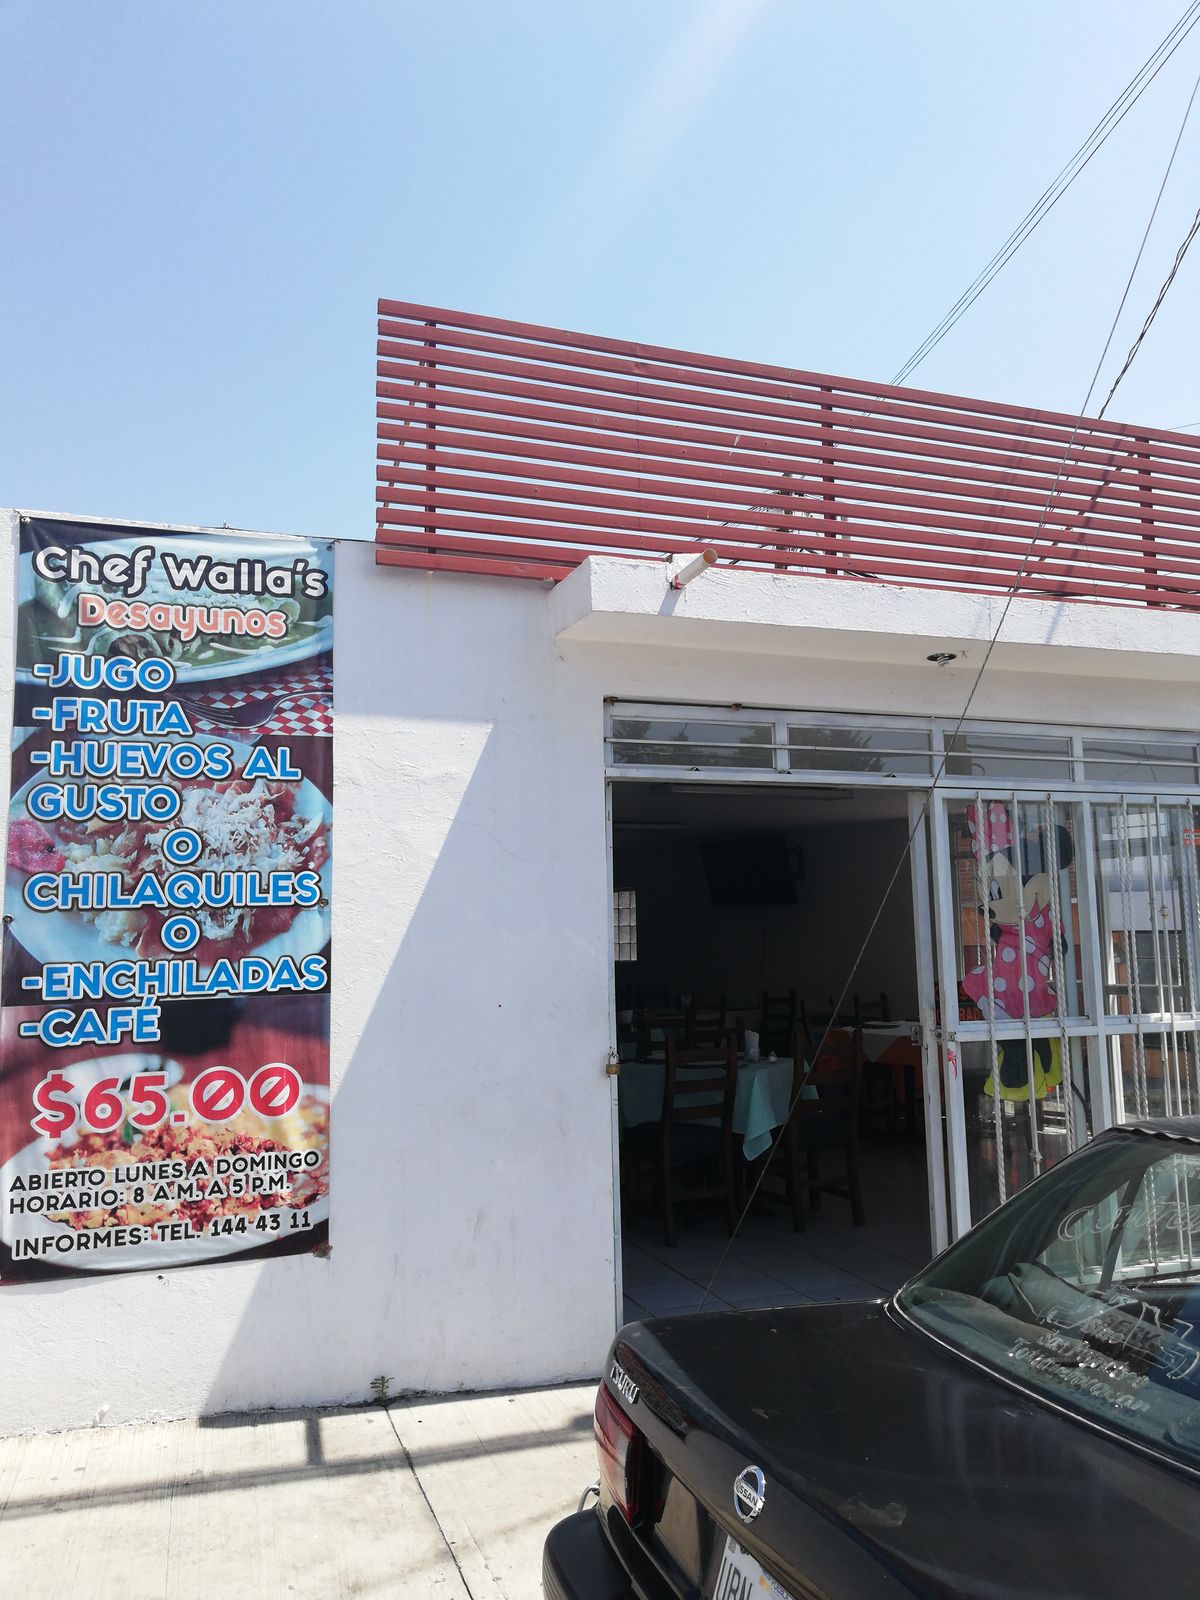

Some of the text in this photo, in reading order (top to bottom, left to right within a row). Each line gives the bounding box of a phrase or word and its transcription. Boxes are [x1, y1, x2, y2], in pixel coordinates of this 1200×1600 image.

[36, 546, 325, 596] Chef Walla's
[78, 593, 287, 640] Desayunos
[33, 654, 174, 691] -JUGO
[32, 697, 192, 735] -FRUTA
[30, 741, 302, 779] -HUEVOS AL
[28, 784, 181, 821] GUSTO
[163, 827, 201, 864] O
[24, 871, 321, 909] CHILAQUILES
[161, 915, 200, 952] O
[22, 956, 328, 1000] -ENCHILADAS
[20, 995, 161, 1046] -CAFÉ
[30, 1063, 303, 1140] $65.00
[9, 1151, 320, 1192] ABIERTO LUNES A DOMINGO
[9, 1174, 290, 1214] HORARIO: 8 A.M. A 5 P.M.
[15, 1211, 311, 1257] INFORMES: TEL. 144 43 11
[610, 1360, 640, 1404] TSURU
